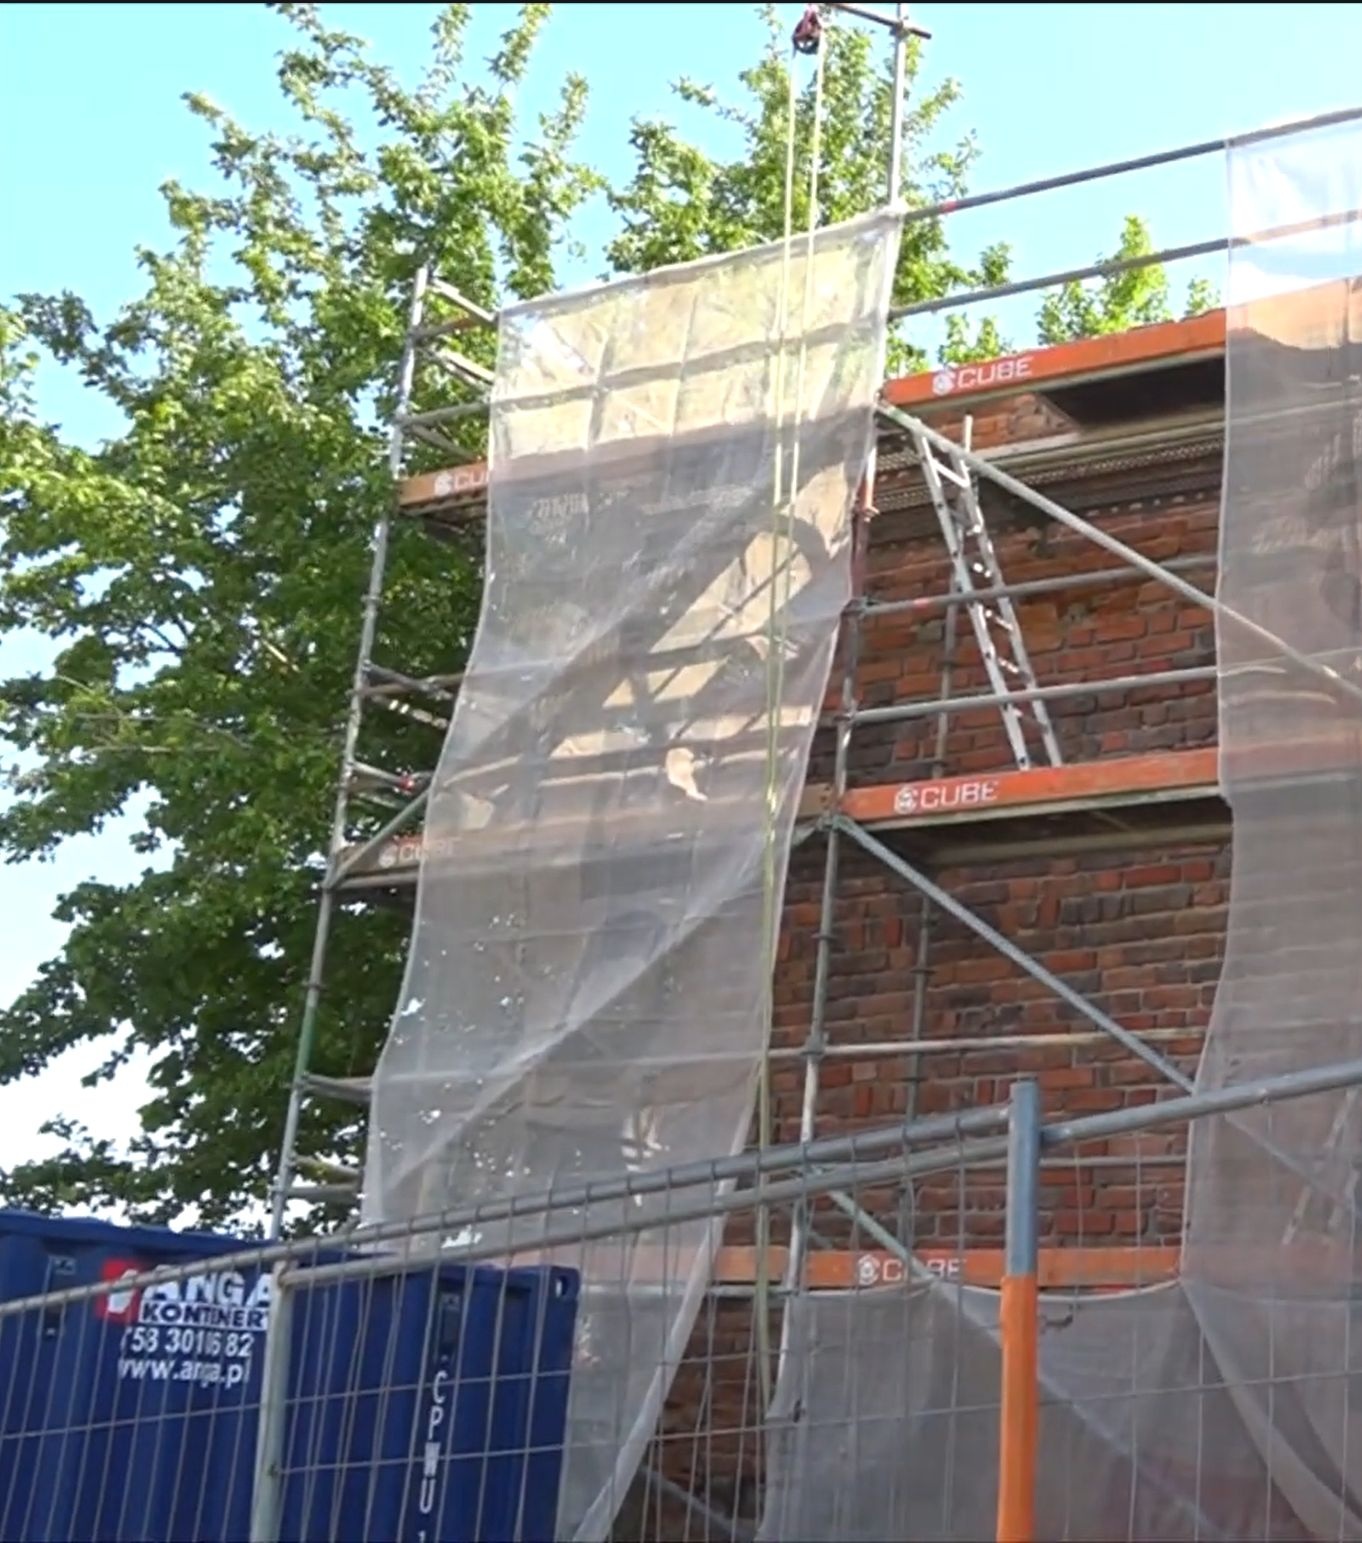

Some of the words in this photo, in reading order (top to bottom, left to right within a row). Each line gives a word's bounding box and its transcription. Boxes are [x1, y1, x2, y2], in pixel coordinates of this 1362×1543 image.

[956, 356, 1035, 389] CUBE
[453, 470, 490, 491] CU
[920, 780, 999, 809] CUBE
[882, 1257, 967, 1282] CBE
